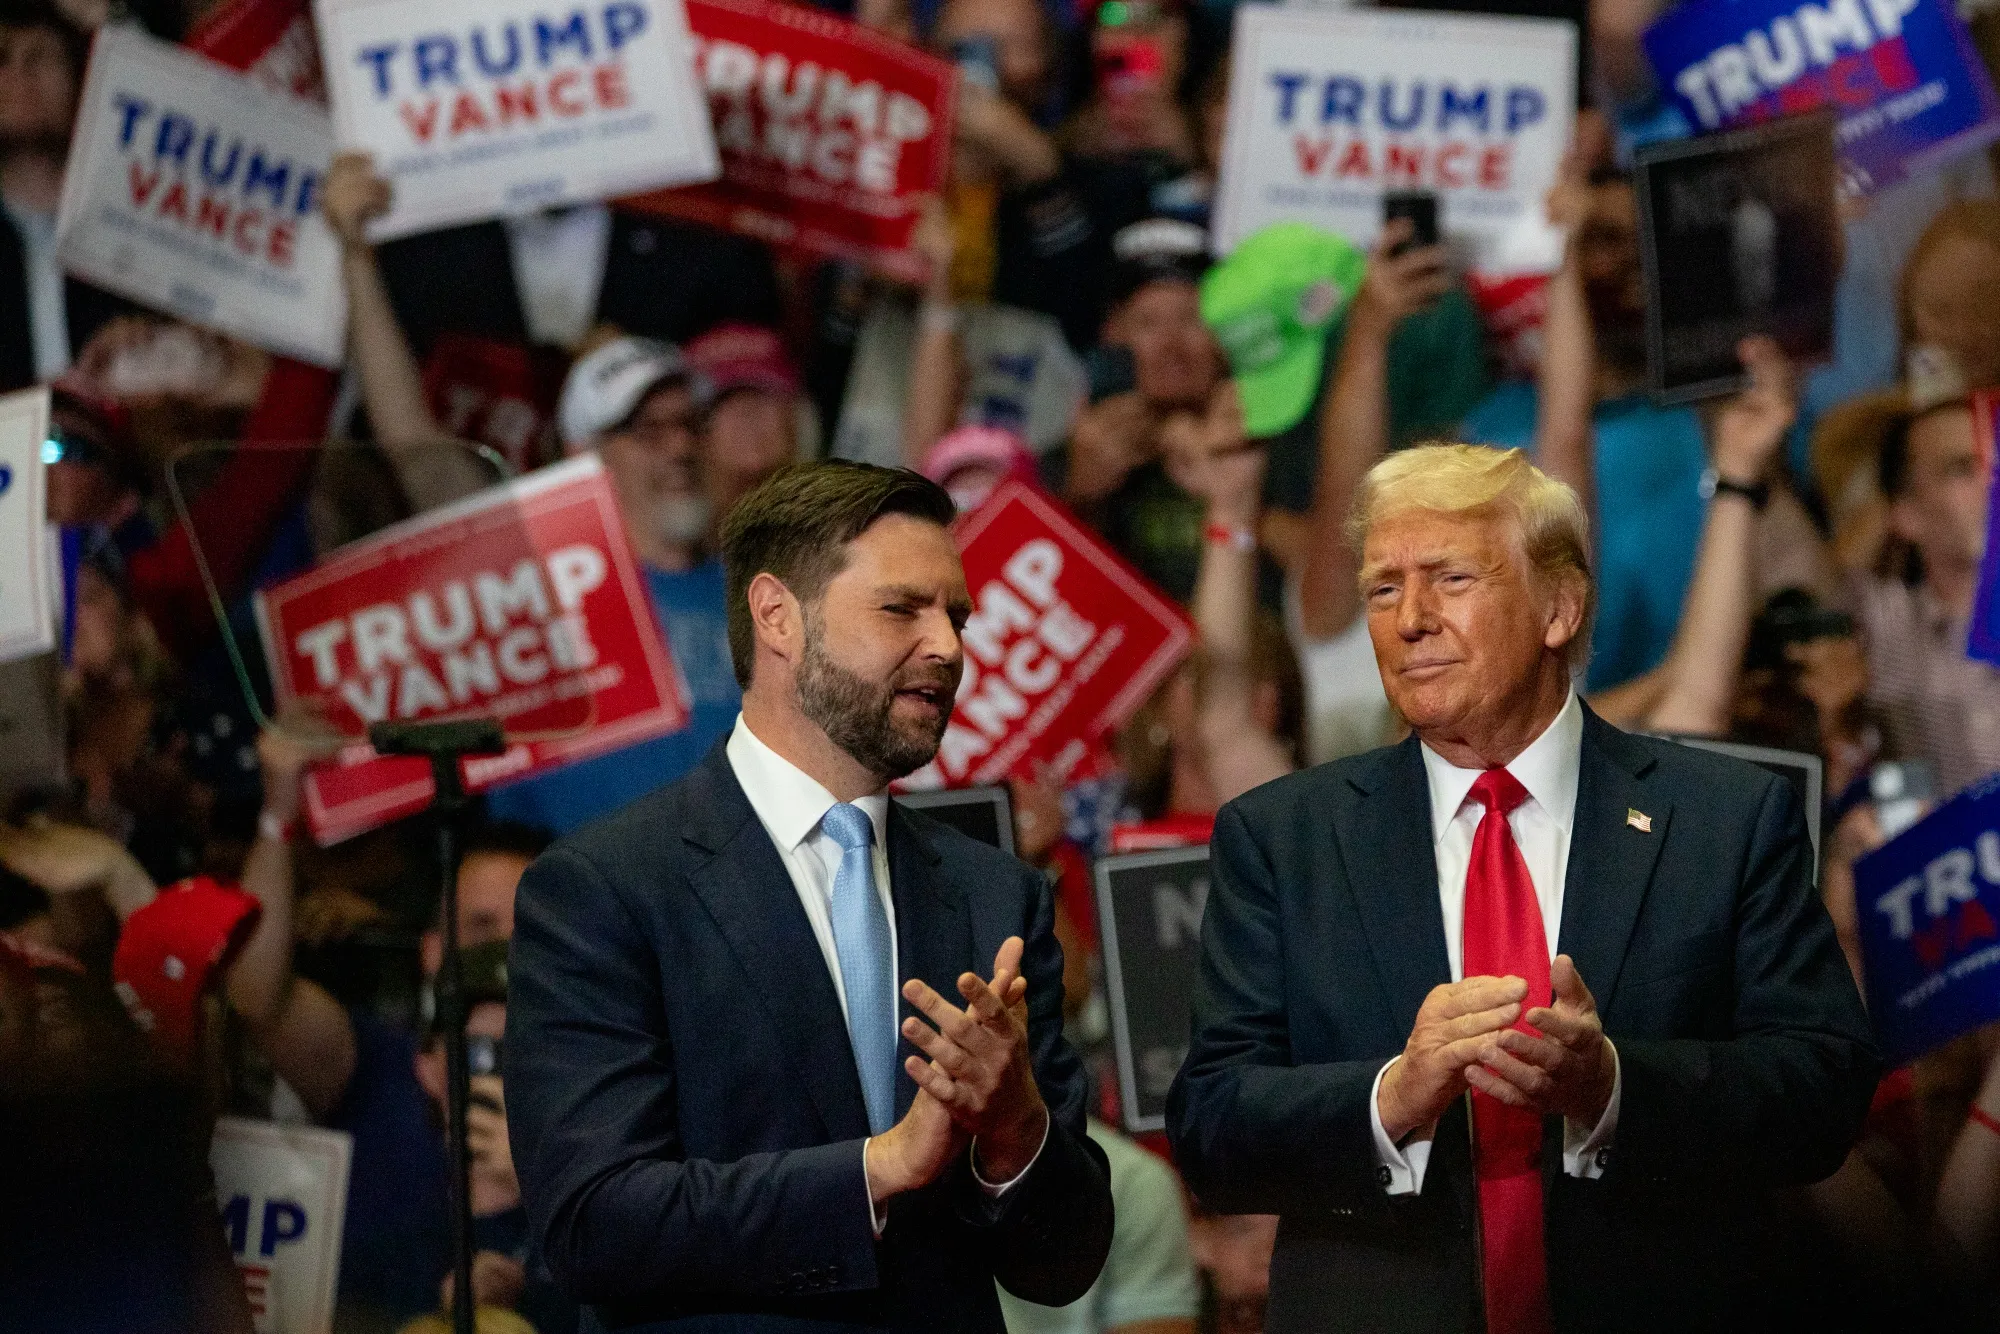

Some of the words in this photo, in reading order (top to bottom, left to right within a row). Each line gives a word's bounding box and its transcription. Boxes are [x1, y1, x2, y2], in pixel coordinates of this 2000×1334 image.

[357, 1, 650, 98] TRUMP
[692, 39, 930, 142] RUMP
[399, 62, 634, 142] VANCE
[1267, 69, 1547, 136] TRUMP
[716, 108, 901, 196] ANCE
[1293, 135, 1513, 189] VANCE
[128, 160, 297, 270] VANCE
[296, 545, 607, 688] TRUMP
[341, 613, 599, 722] VANCE
